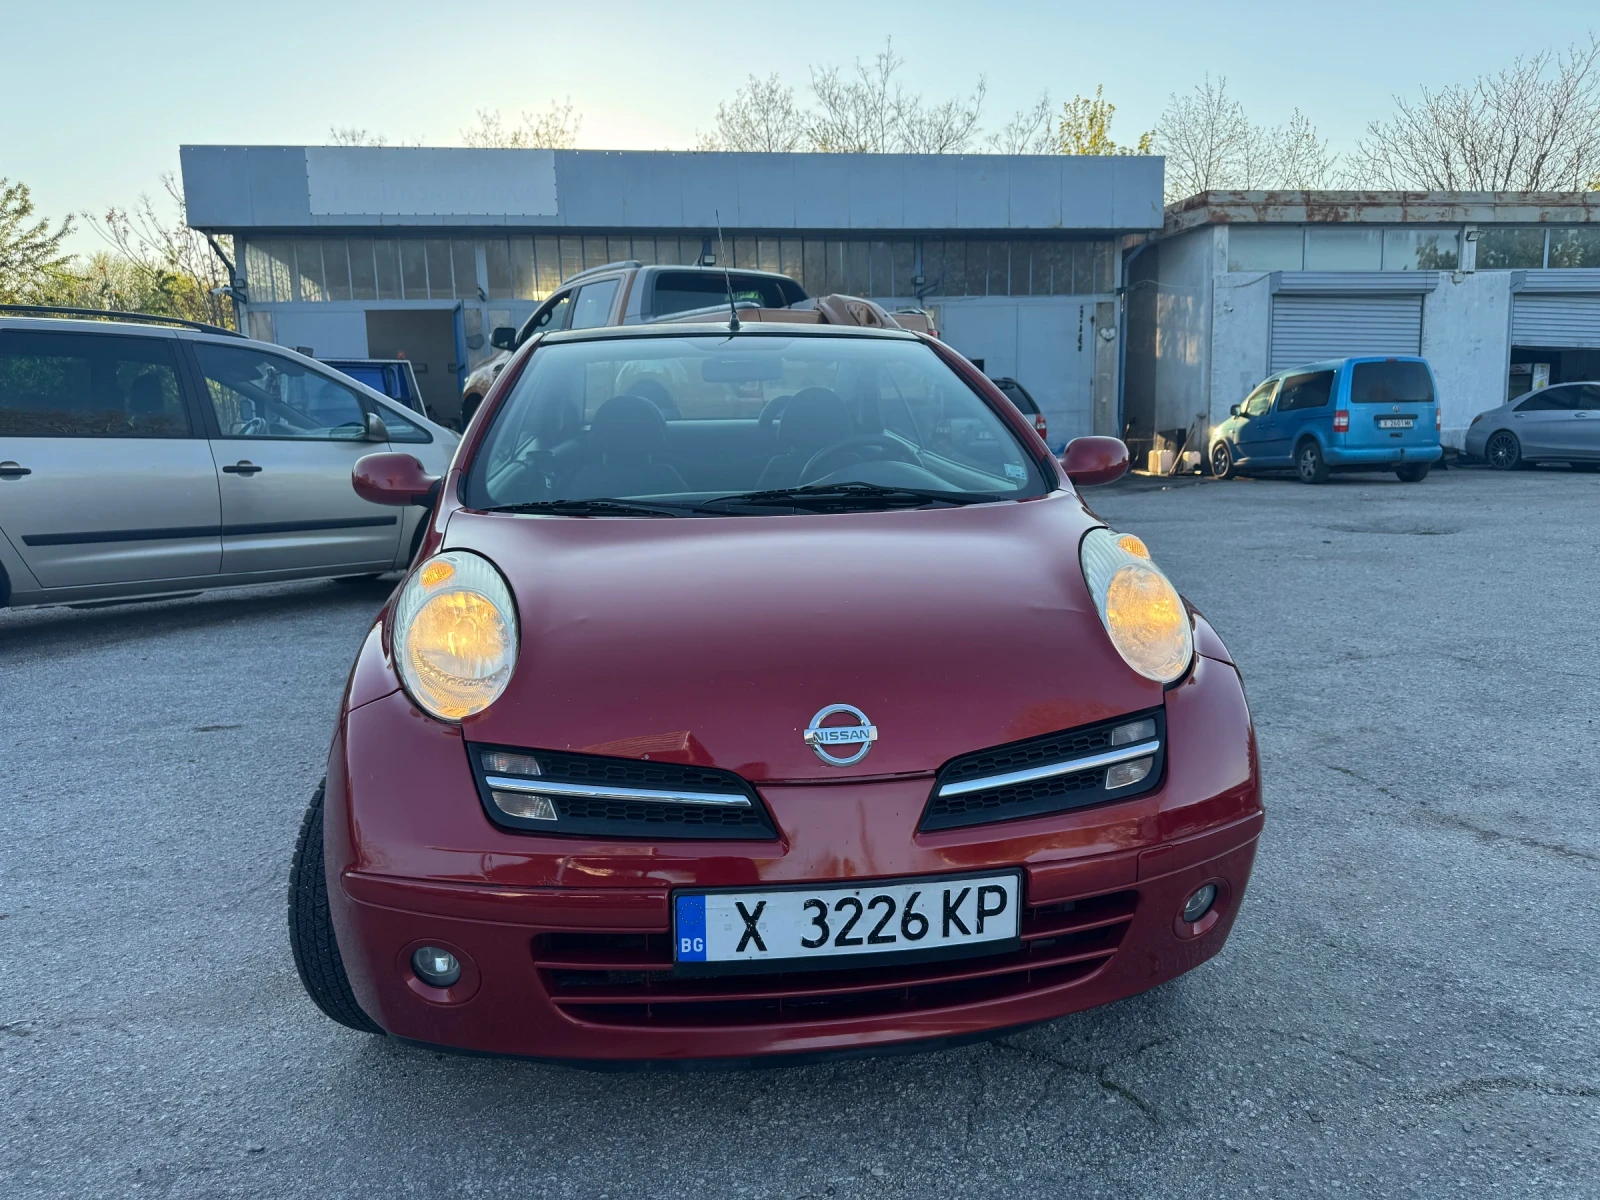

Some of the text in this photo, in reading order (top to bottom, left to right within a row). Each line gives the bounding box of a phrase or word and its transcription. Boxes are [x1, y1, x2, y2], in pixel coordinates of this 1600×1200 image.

[812, 729, 870, 741] NISSAN
[735, 885, 1008, 953] X 3226 KP
[681, 938, 704, 954] BG
